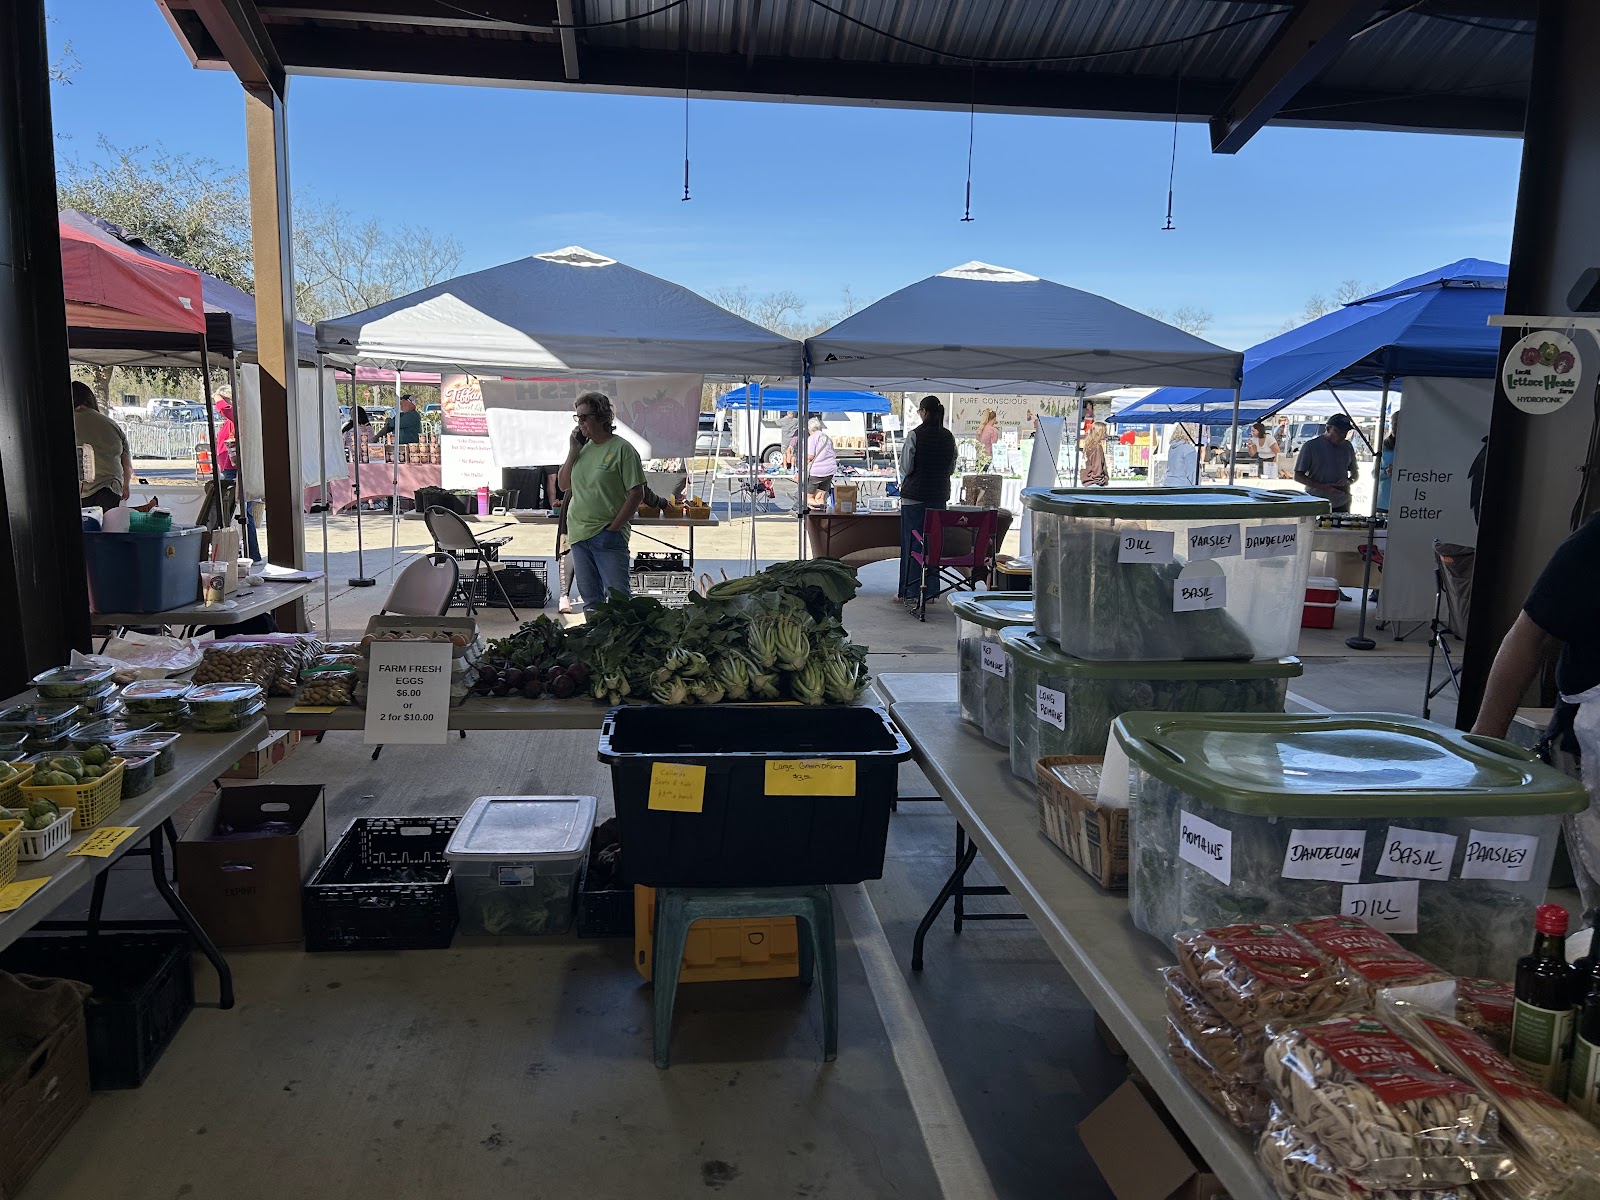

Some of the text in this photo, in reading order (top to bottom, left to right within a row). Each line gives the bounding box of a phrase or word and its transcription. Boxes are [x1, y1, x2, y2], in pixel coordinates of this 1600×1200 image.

[1507, 373, 1576, 391] Lettuce Heads
[982, 397, 1028, 405] CONSCIOUS
[1398, 469, 1453, 482] Fresher
[1414, 488, 1426, 501] Is
[1400, 506, 1442, 519] Better
[1125, 537, 1154, 551] DILL
[1190, 534, 1232, 548] PARSLEY
[1245, 533, 1296, 548] DANDELION
[1181, 587, 1214, 600] BASIL
[982, 645, 992, 654] RED
[378, 664, 442, 673] FARM FRESH
[395, 677, 424, 685] EGGS
[396, 689, 421, 697] $6.00
[1039, 689, 1055, 704] LONG
[380, 713, 434, 721] 2 for $10.00
[772, 761, 794, 772] Large
[799, 761, 820, 770] Green
[1181, 825, 1224, 858] ROMAINE
[1290, 844, 1361, 862] DANDELION
[1389, 840, 1442, 866] BASIL
[1466, 841, 1527, 864] PARSLEY
[1351, 899, 1401, 916] DILL
[1325, 935, 1390, 947] ITALIAN
[1341, 940, 1388, 950] PASTA
[1234, 943, 1301, 955] ITALIAN
[1249, 949, 1301, 959] PASTA
